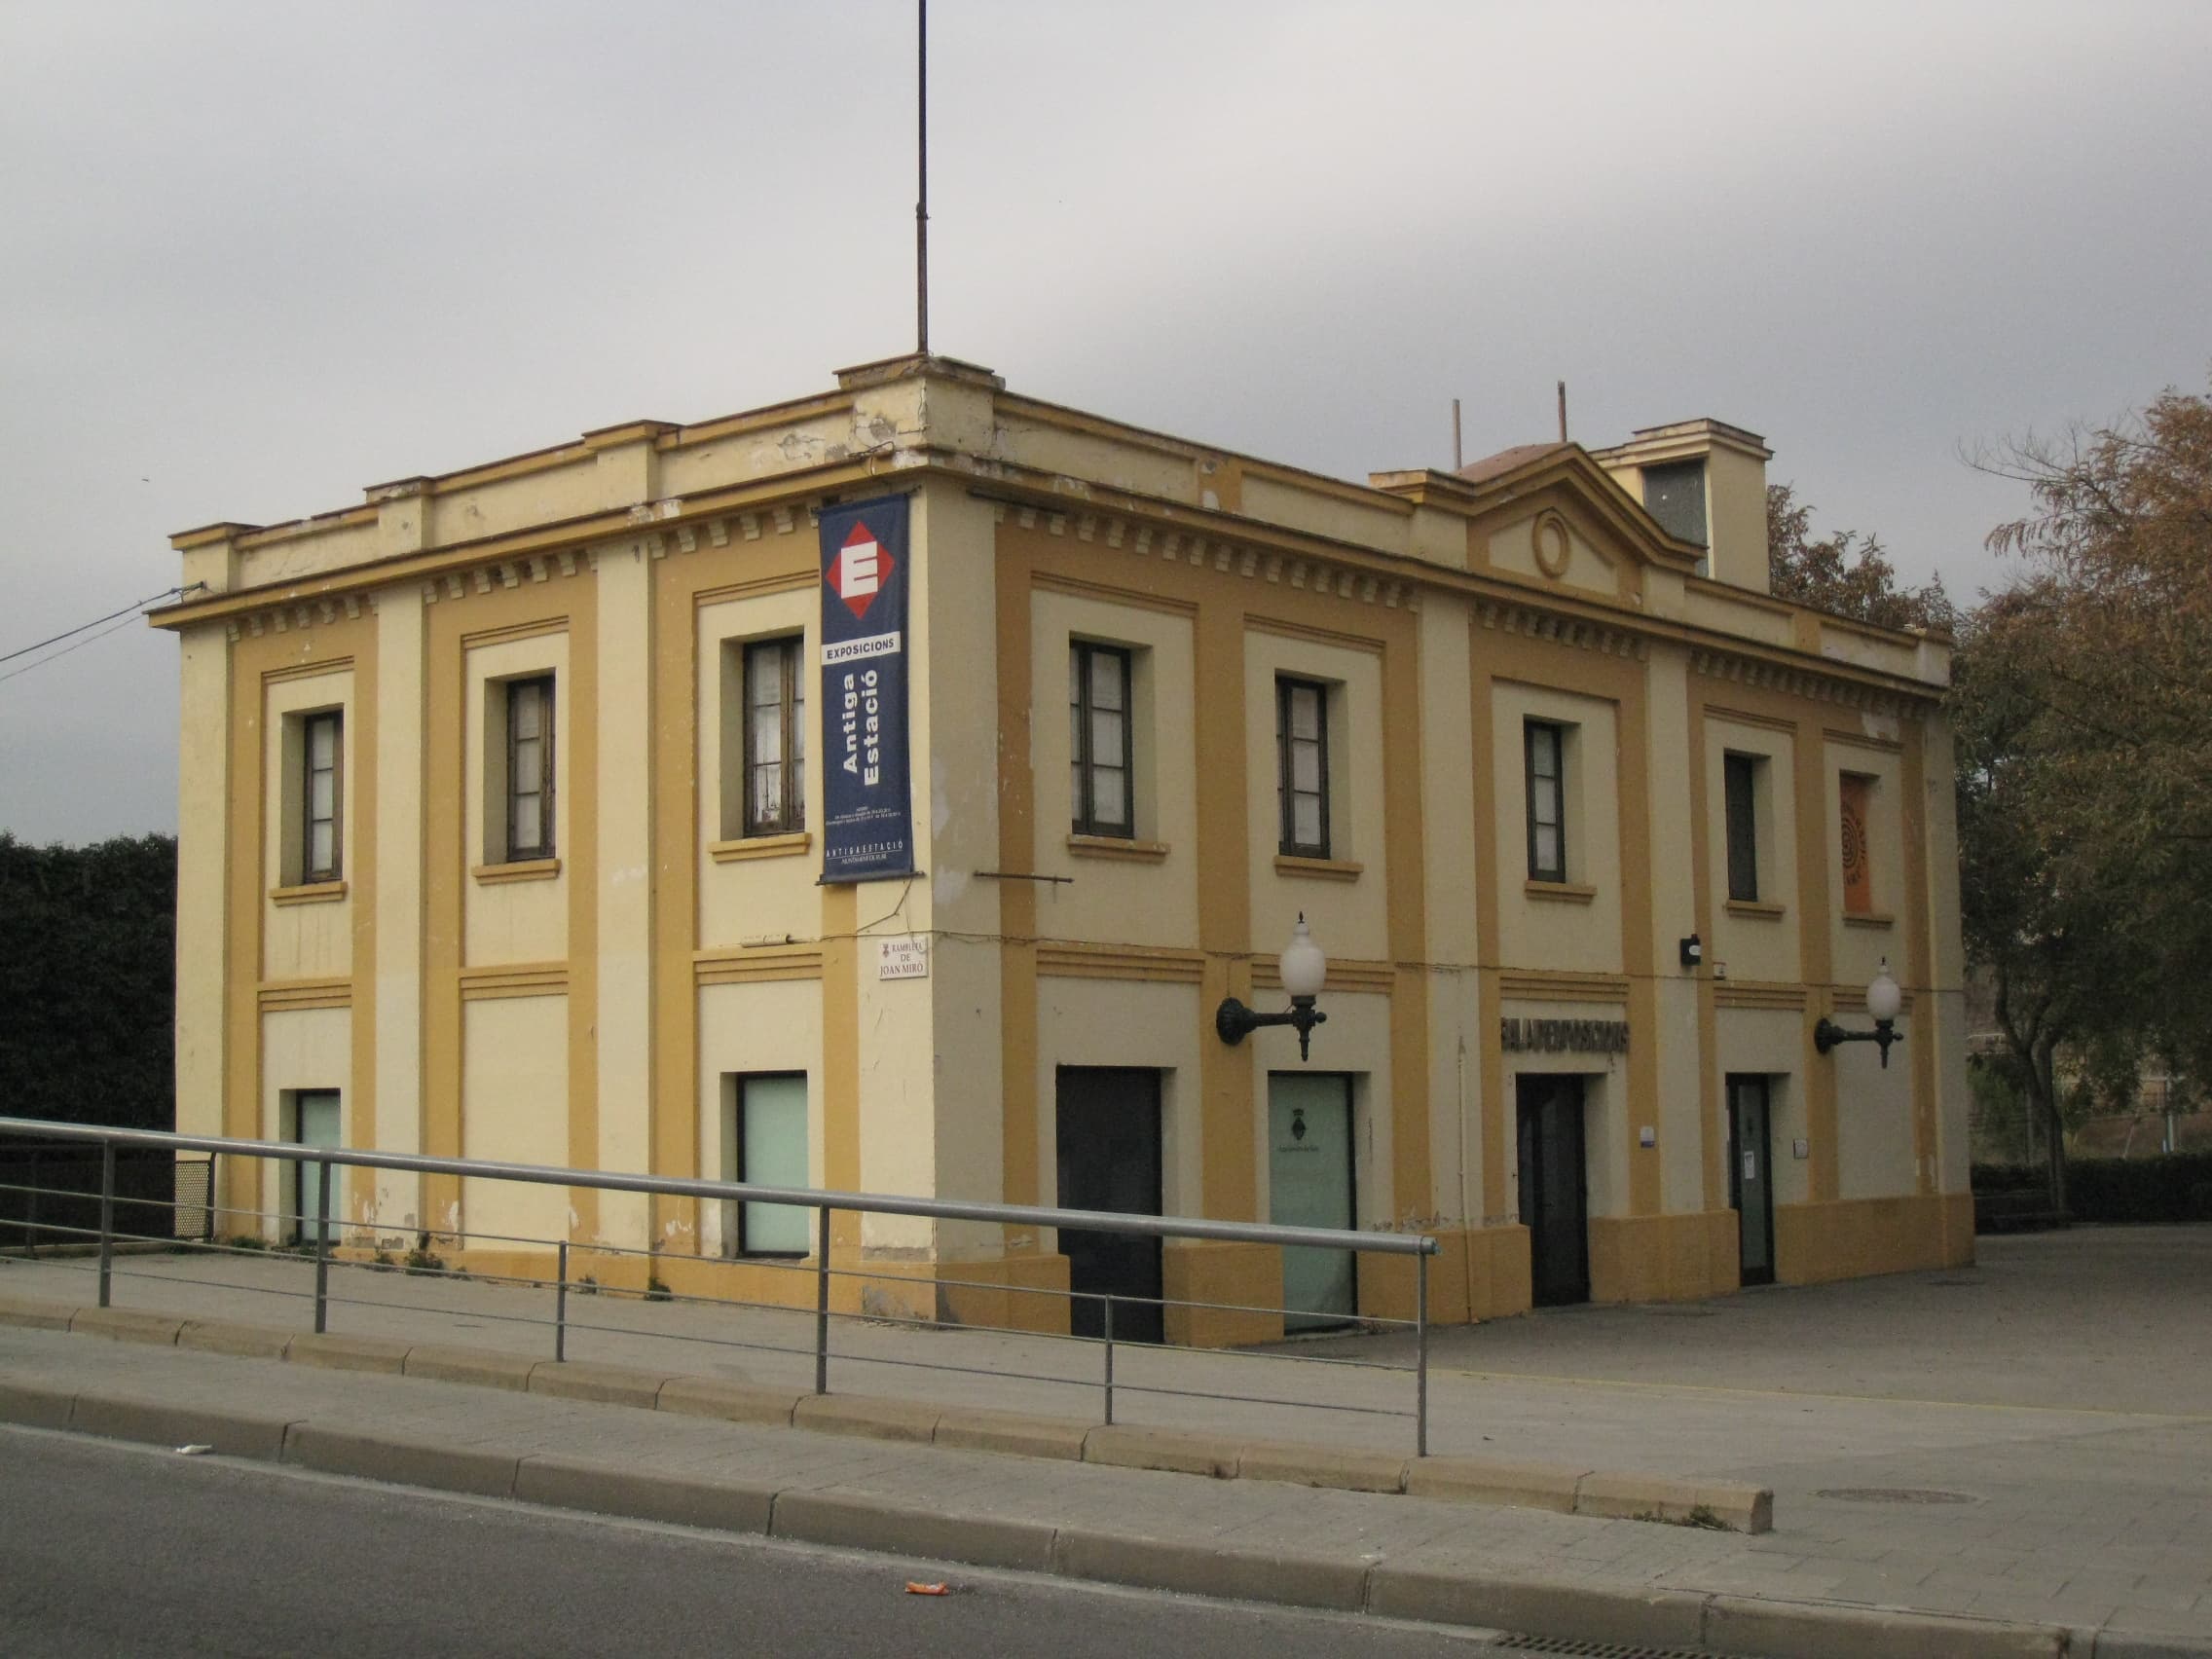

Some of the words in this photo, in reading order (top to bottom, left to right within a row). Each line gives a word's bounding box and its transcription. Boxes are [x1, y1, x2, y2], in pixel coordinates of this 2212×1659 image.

[841, 540, 878, 599] E
[827, 638, 895, 659] EXPOSICIONS
[842, 673, 858, 774] Antiga
[861, 670, 879, 786] Estació
[880, 965, 901, 977] JOAN
[902, 960, 924, 974] MIRÓ
[901, 953, 911, 962] DE
